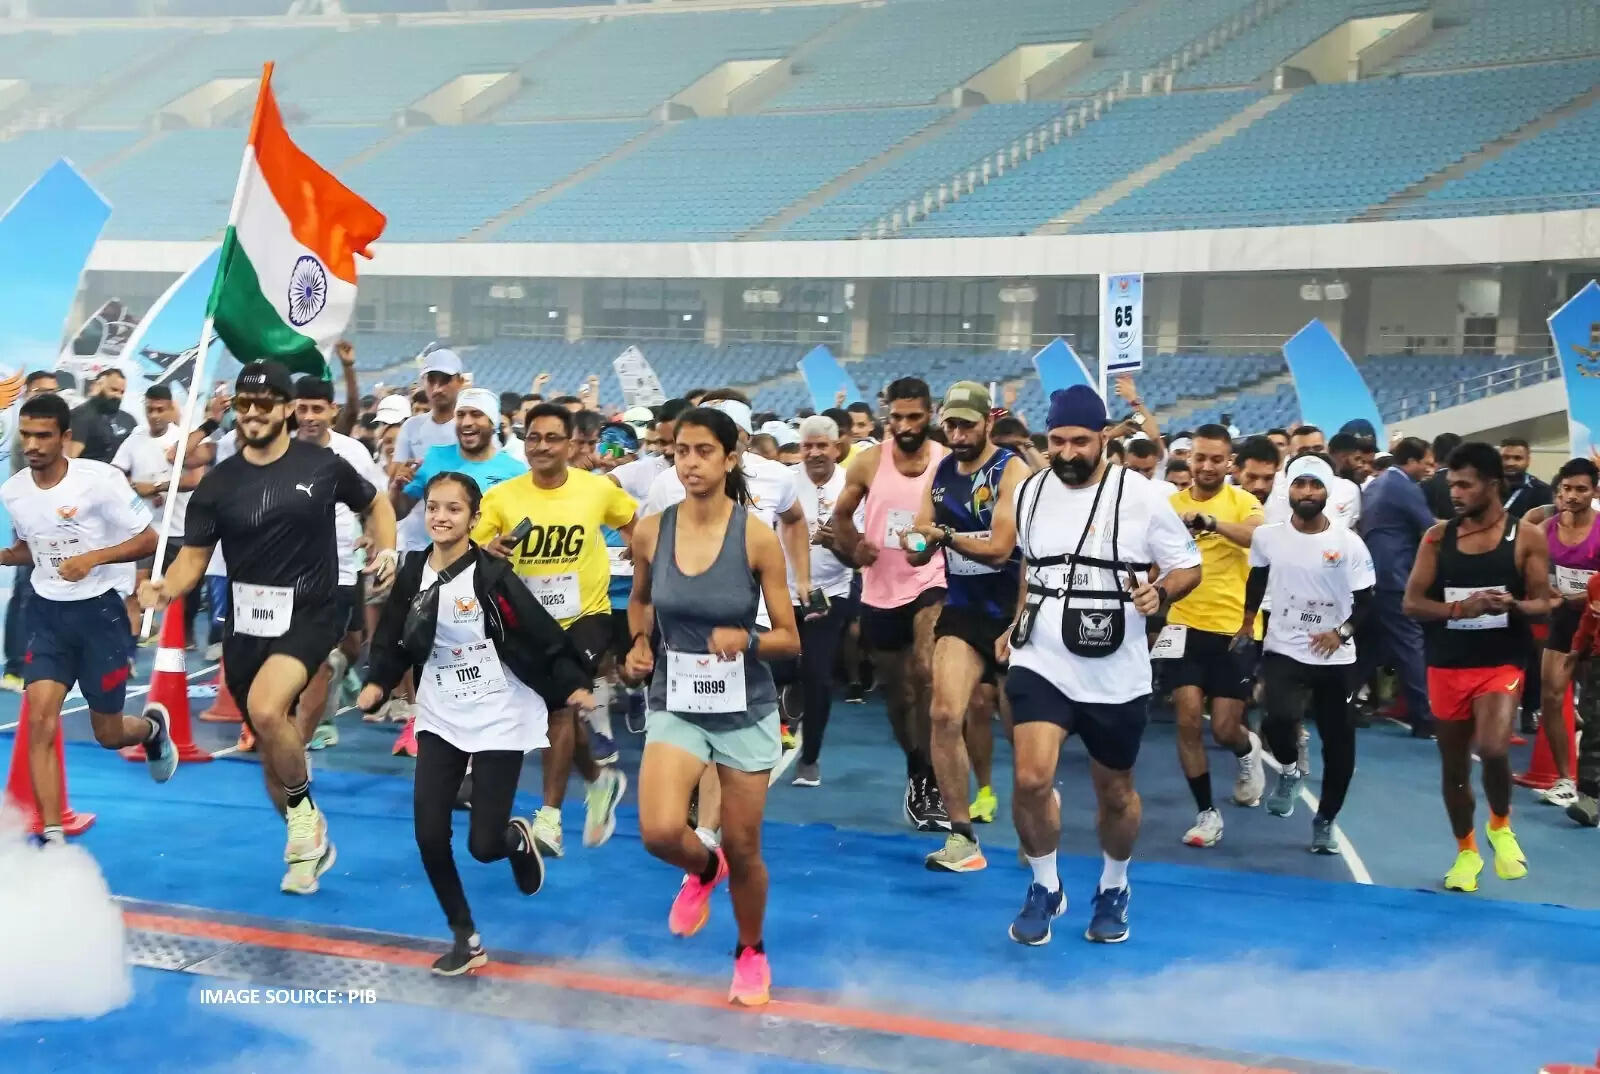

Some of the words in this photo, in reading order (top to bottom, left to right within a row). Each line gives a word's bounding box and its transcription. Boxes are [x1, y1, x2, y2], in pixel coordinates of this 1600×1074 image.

[1115, 305, 1133, 328] 65
[455, 666, 482, 683] 17112
[692, 679, 726, 695] 13899
